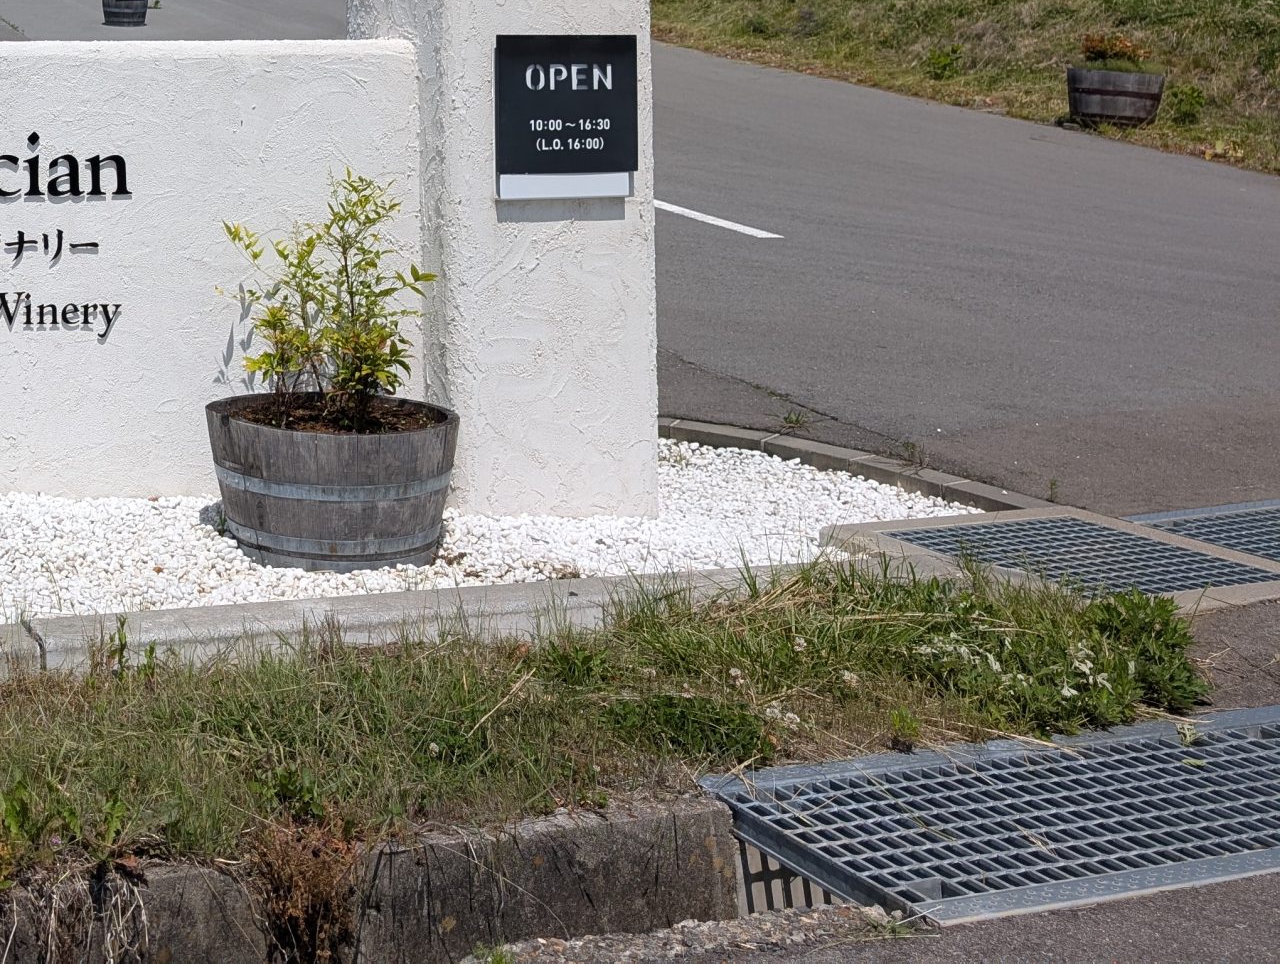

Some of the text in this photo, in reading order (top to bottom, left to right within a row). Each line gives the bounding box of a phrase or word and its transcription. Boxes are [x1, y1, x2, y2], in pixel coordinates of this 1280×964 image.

[525, 63, 613, 91] OPEN
[535, 137, 605, 151] (L.O. 16:00)
